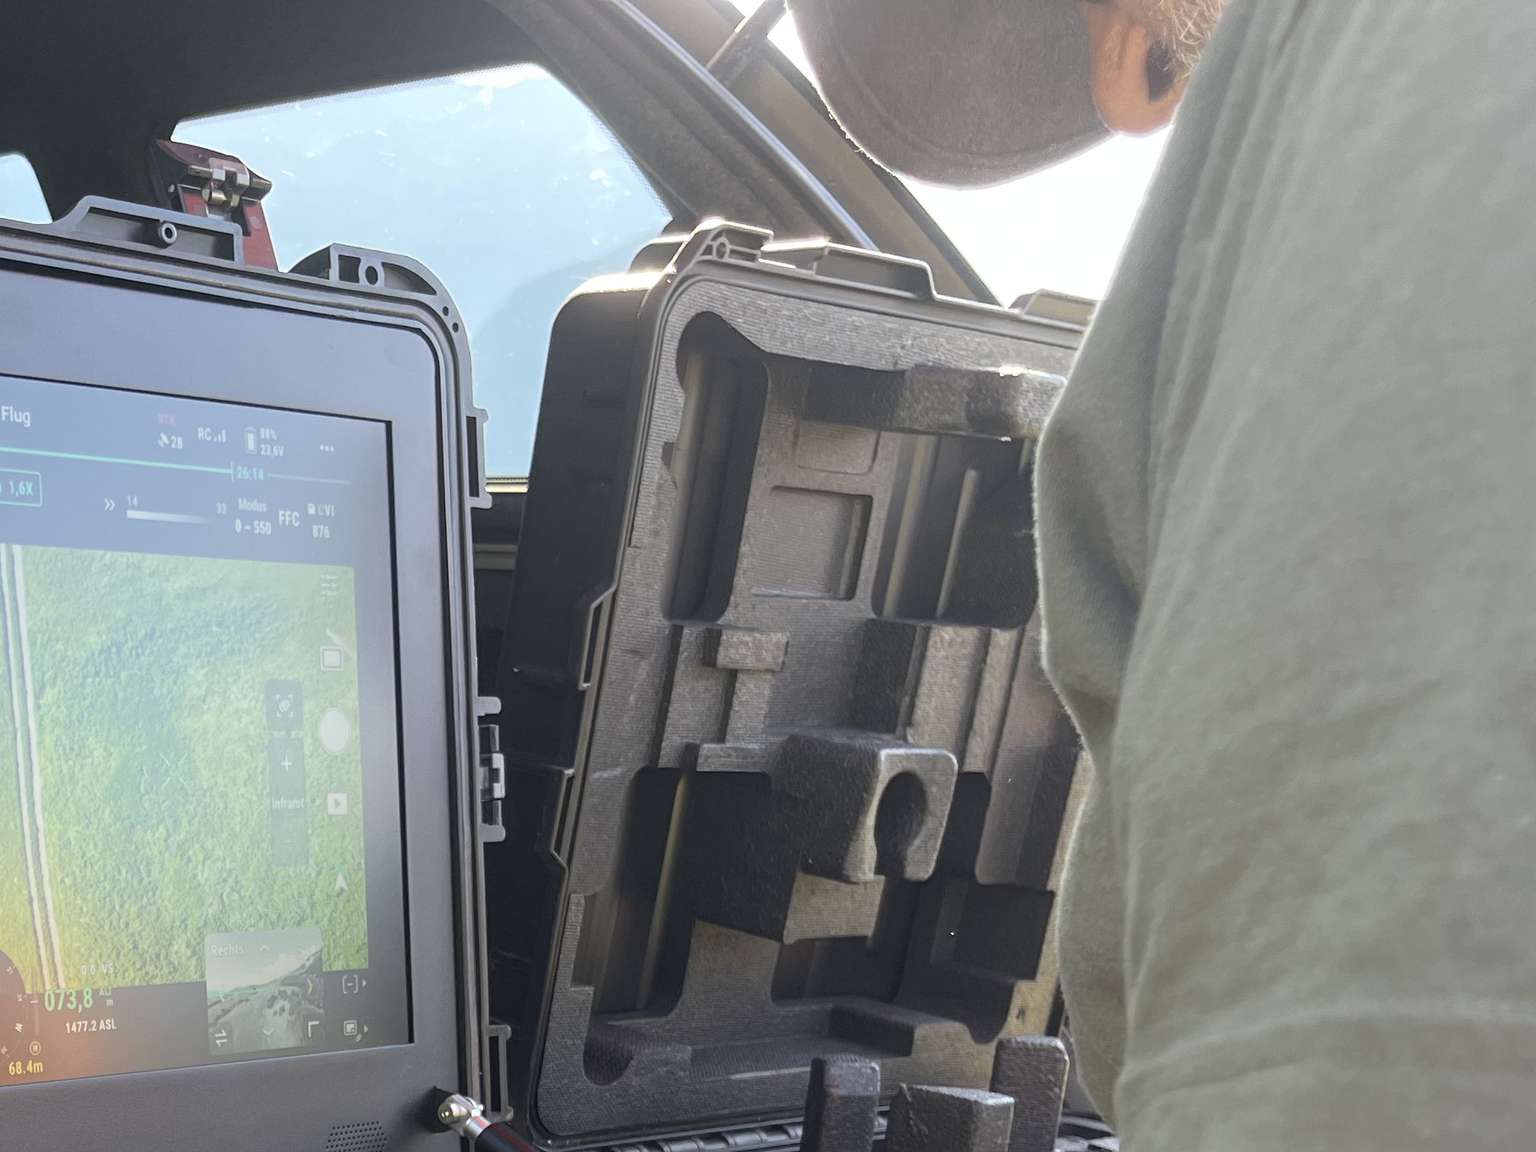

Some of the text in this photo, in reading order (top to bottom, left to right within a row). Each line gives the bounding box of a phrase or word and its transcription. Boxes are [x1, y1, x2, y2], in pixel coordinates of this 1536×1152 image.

[1, 403, 31, 427] Flug
[198, 428, 212, 441] RC
[278, 510, 301, 527] FFC
[44, 987, 93, 1013] 073,8
[99, 1018, 117, 1031] ASL
